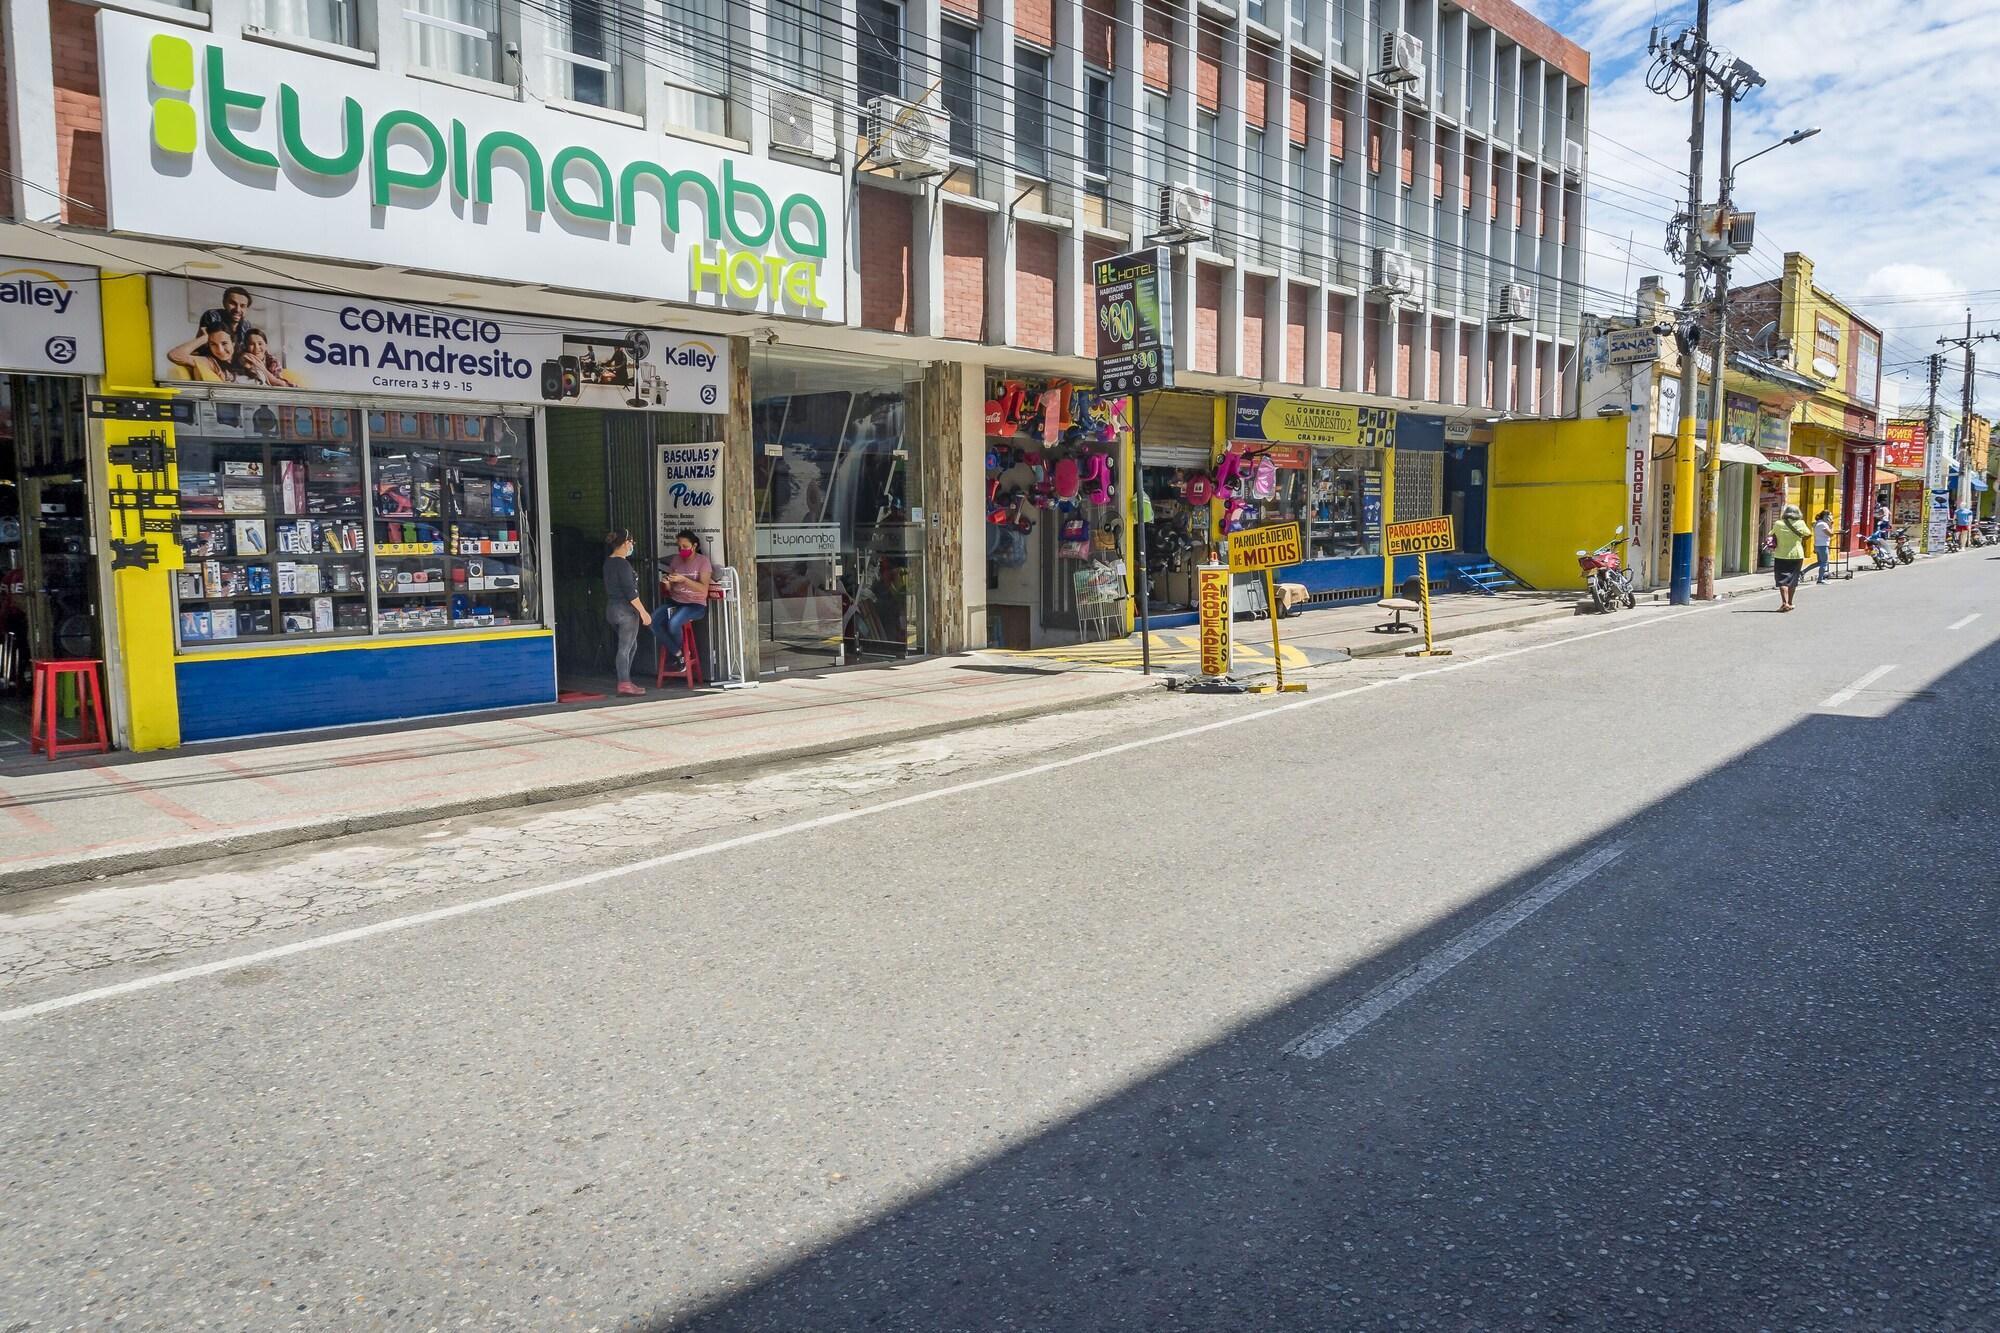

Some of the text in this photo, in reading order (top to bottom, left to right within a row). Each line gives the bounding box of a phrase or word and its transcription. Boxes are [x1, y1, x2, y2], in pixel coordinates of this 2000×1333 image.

[205, 45, 829, 258] tupinamba
[690, 243, 828, 310] HOTEL
[1117, 264, 1155, 280] HOTEL
[1100, 282, 1133, 295] HABITACIONES
[1109, 293, 1124, 301] DESDE
[339, 307, 501, 343] COMERCIO
[1611, 338, 1656, 352] SANAR
[304, 334, 533, 379] San Andresito
[666, 347, 717, 372] Kalley
[372, 376, 418, 389] Carrera
[421, 379, 429, 389] 3
[432, 381, 439, 390] #
[443, 381, 451, 390] 9
[462, 382, 473, 392] 15
[1285, 413, 1301, 426] SAN
[1302, 414, 1346, 430] ANDRESITO
[1297, 407, 1341, 417] COMERCIO
[1887, 428, 1913, 439] POWER
[663, 448, 719, 463] BASCULAS Y
[667, 465, 715, 479] BALANZAS
[669, 482, 714, 508] Persa
[1632, 450, 1644, 547] DROGUERIA
[1389, 519, 1448, 539] PARQUEADERO
[1661, 484, 1670, 555] DROGUERIA
[1233, 527, 1293, 549] PARQUEADERO
[1391, 533, 1449, 552] DE MOTOS
[1234, 543, 1296, 567] DE MOTOS
[1201, 573, 1220, 675] PARQUEADERO
[1220, 585, 1228, 662] MOTOS
